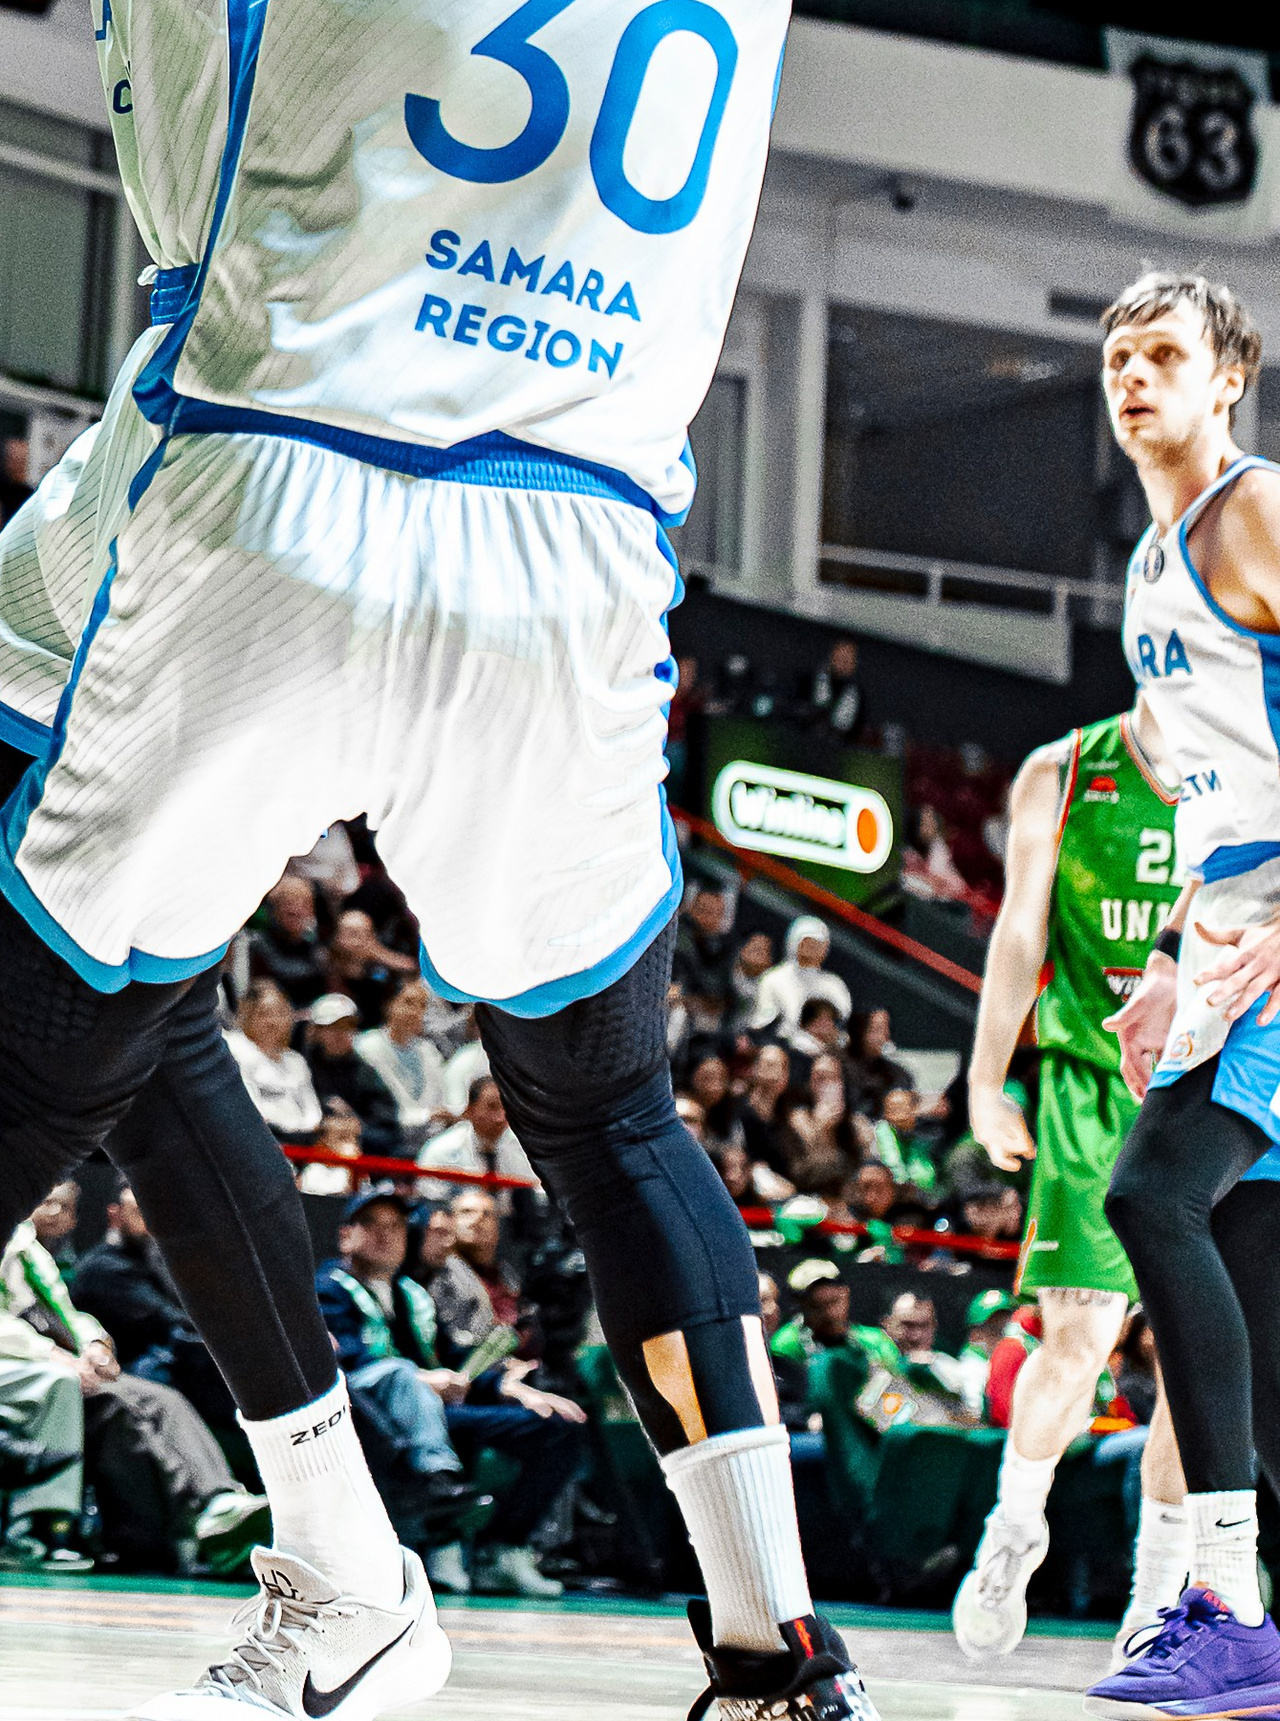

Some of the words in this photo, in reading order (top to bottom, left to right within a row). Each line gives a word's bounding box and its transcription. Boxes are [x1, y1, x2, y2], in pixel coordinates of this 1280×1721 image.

[1143, 103, 1241, 189] 63
[425, 229, 641, 322] SAMARA
[414, 293, 624, 380] REGION
